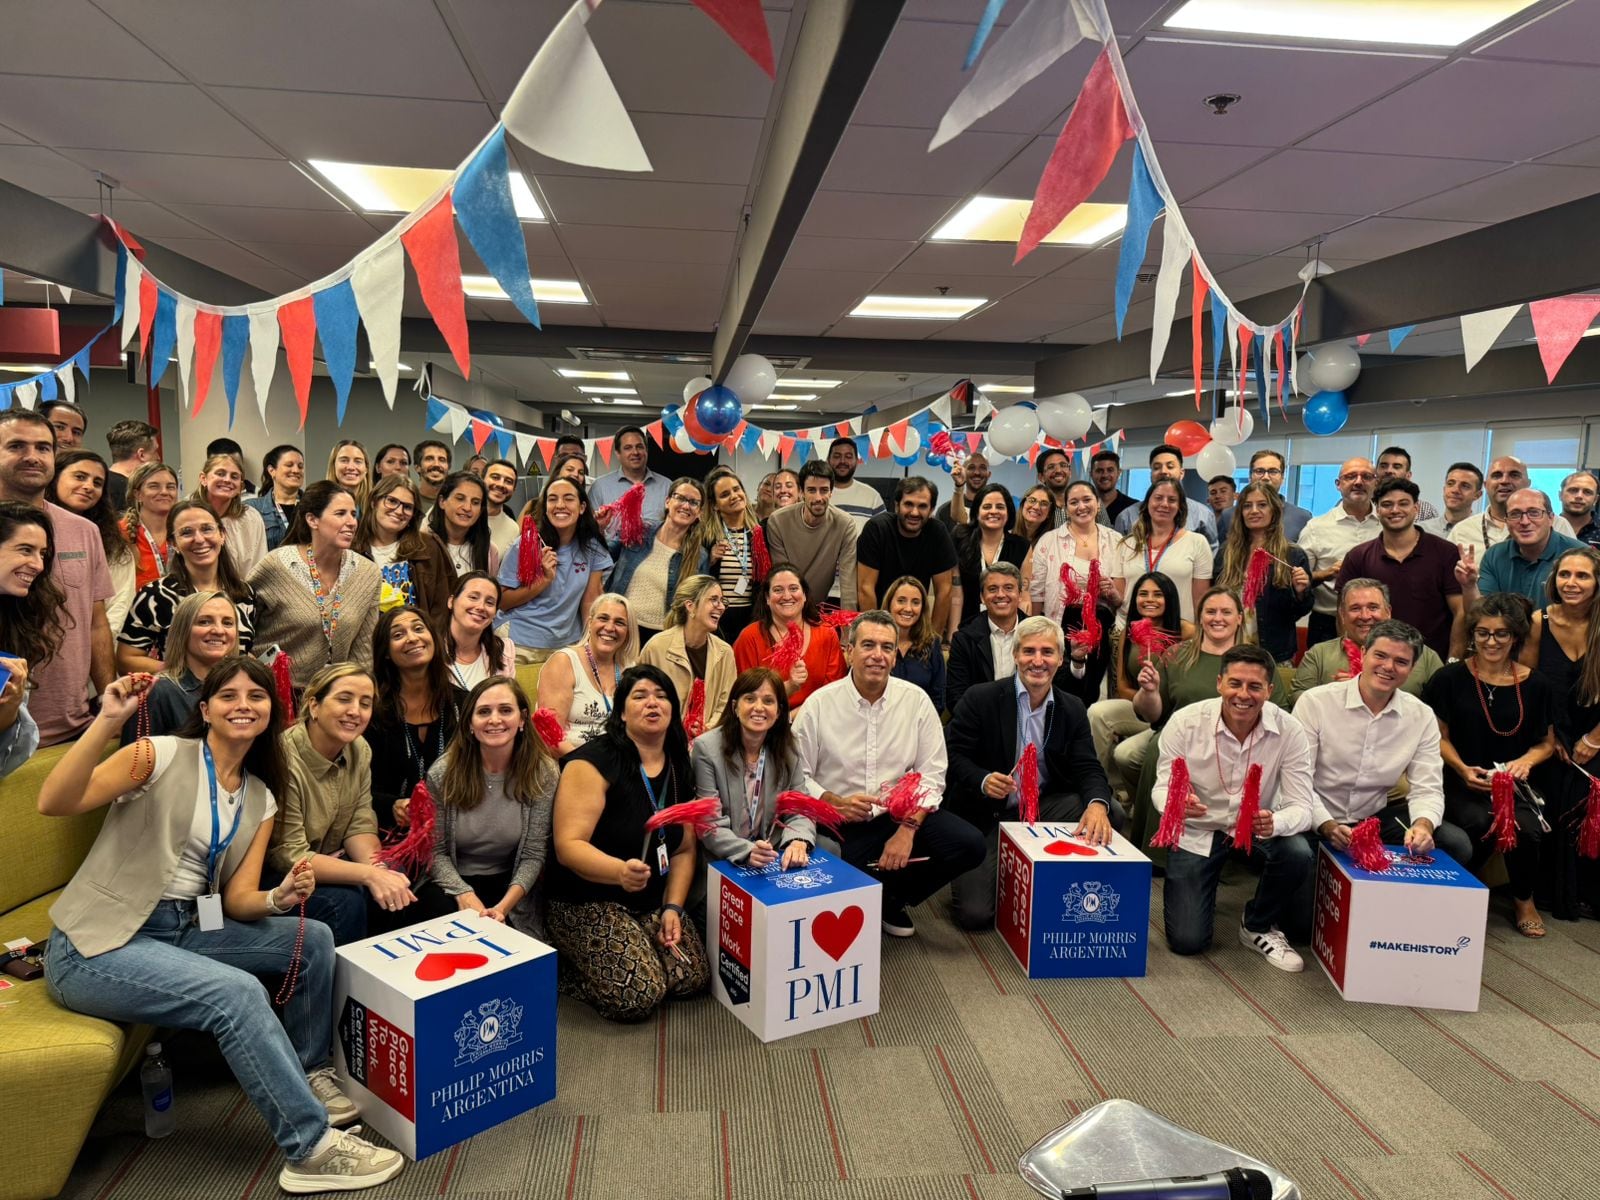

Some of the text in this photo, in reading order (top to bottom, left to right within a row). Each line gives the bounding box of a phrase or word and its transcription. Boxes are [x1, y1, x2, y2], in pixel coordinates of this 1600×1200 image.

[1008, 848, 1015, 874] To
[1320, 859, 1342, 900] Great
[721, 884, 744, 912] Great
[1013, 856, 1022, 926] Place
[1020, 864, 1029, 937] Great
[1319, 882, 1340, 922] Place
[721, 900, 744, 926] Place
[721, 914, 730, 930] To
[1317, 903, 1325, 928] To
[366, 919, 486, 961] PMI
[468, 935, 521, 959] I
[788, 917, 808, 972] I
[1042, 932, 1137, 944] PHILIP MORRIS
[1050, 945, 1127, 959] ARGENTINA
[720, 952, 749, 985] Certified
[784, 963, 864, 1022] PMI
[356, 1007, 365, 1081] Certified
[379, 1025, 388, 1046] To
[389, 1030, 399, 1087] Place
[399, 1036, 409, 1096] Great
[431, 1071, 485, 1108] PHILIP
[489, 1047, 544, 1083] MORRIS
[441, 1068, 535, 1123] ARGENTINA
